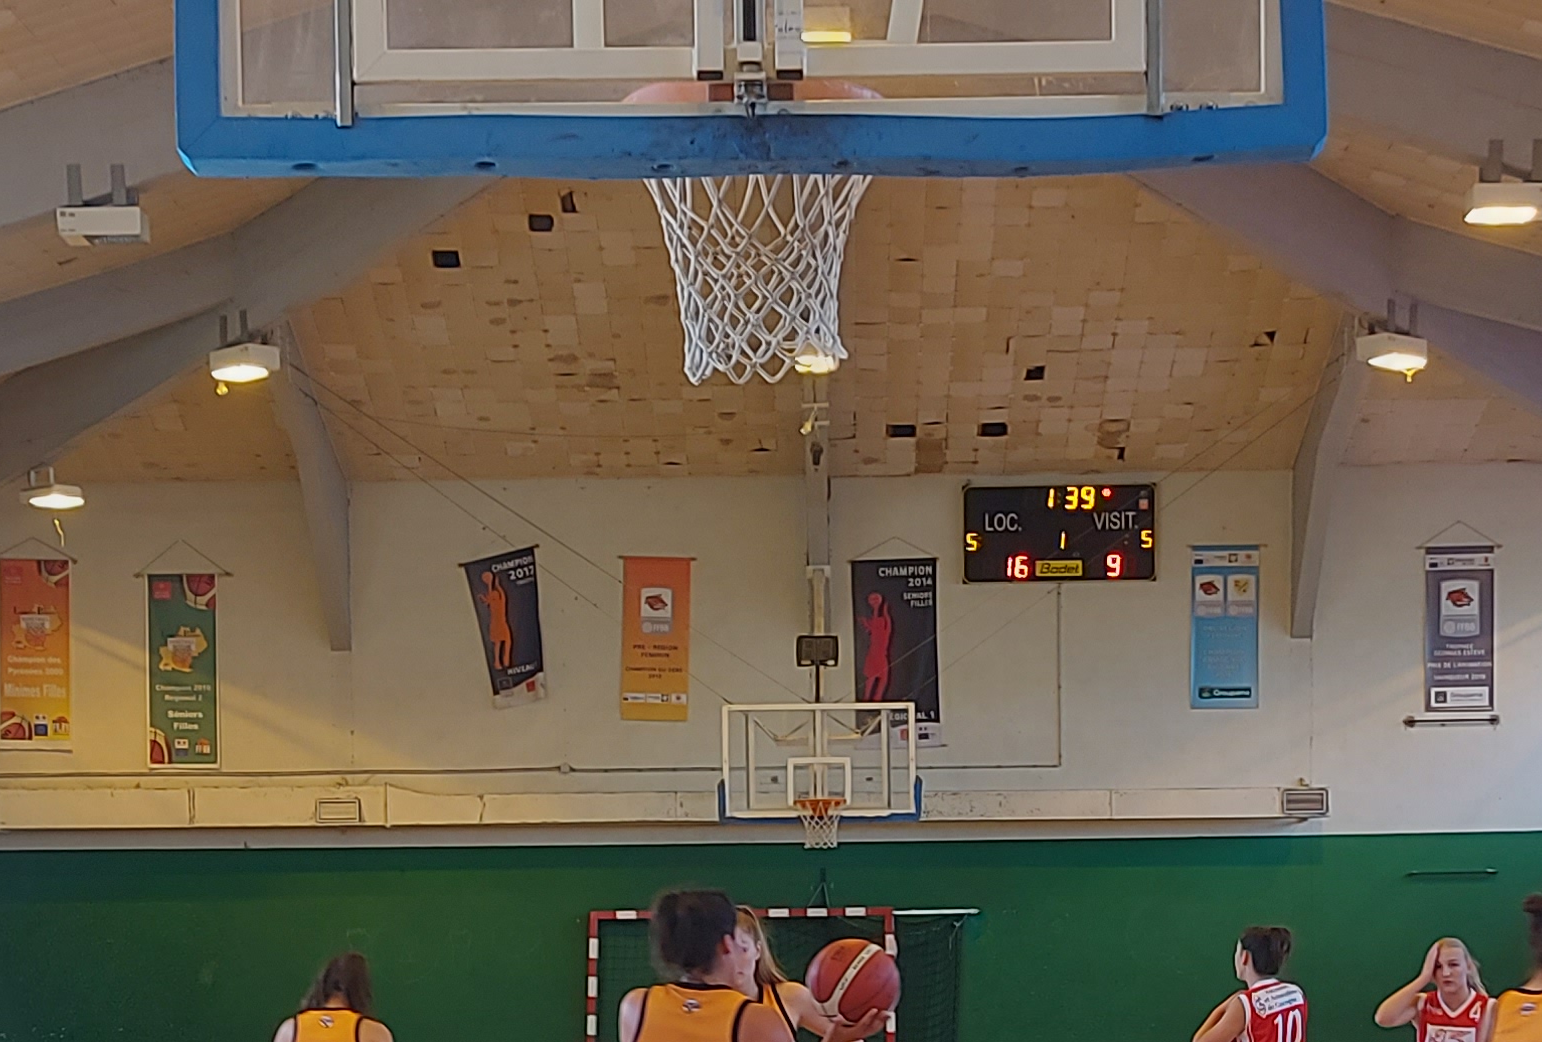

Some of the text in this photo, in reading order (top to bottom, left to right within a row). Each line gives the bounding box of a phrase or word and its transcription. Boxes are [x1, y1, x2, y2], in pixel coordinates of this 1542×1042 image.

[984, 511, 1139, 532] LOC. VISIT.
[965, 529, 1154, 551] 5 1 5
[878, 565, 933, 577] CHAMPION
[1007, 554, 1122, 579] 16 Bodet 9
[908, 578, 933, 587] 2014
[4, 682, 66, 698] Minimes Filles
[1469, 1001, 1482, 1023] 4
